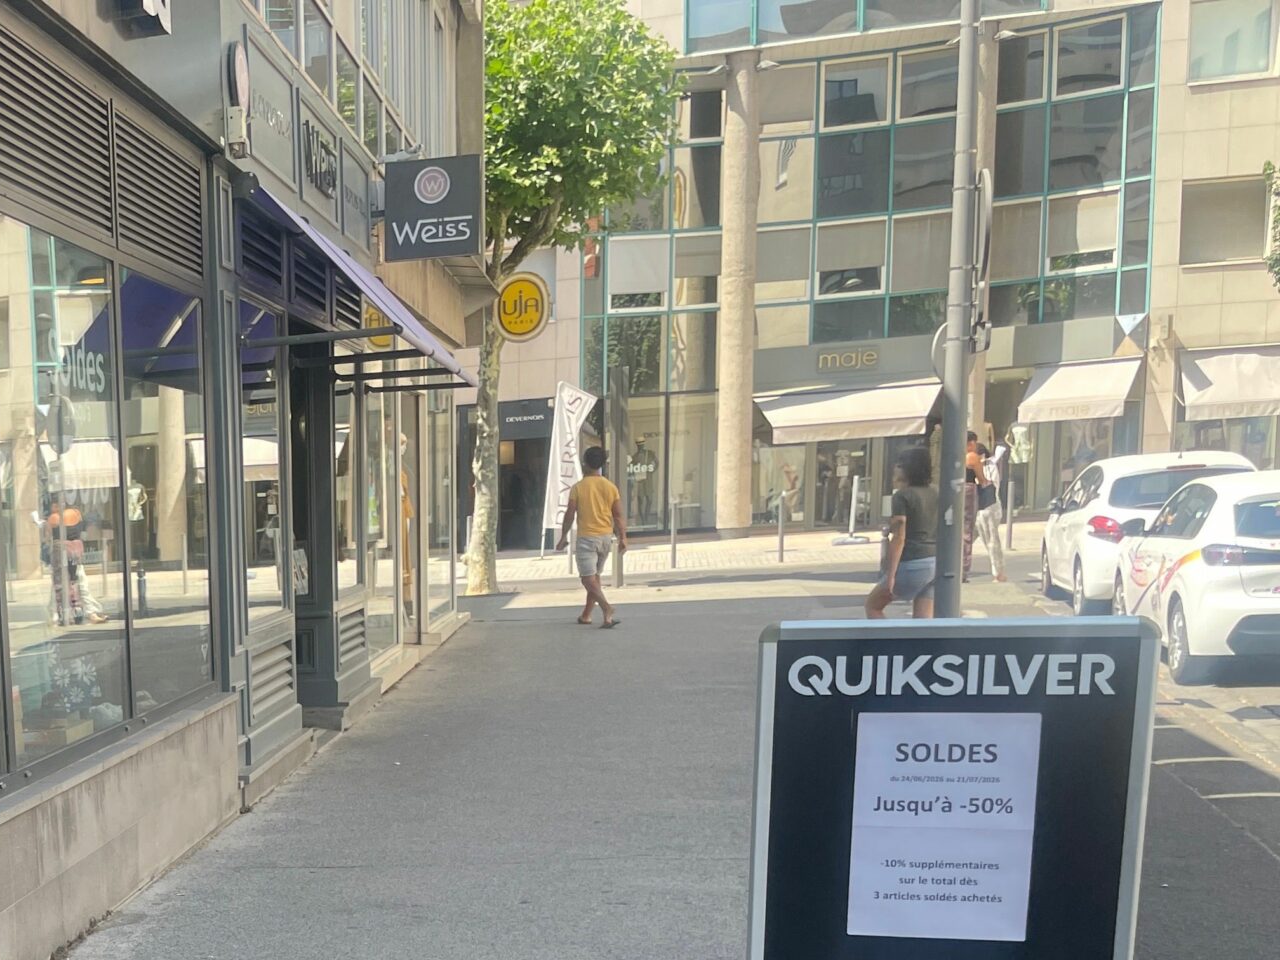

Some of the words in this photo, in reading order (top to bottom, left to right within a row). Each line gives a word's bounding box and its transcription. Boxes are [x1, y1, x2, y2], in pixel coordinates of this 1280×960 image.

[392, 214, 473, 246] Weiss
[818, 347, 878, 369] maje
[505, 414, 545, 423] DEVERNOIS
[787, 653, 1116, 697] QUIKSILVER
[895, 742, 998, 764] SOLDES
[890, 775, 901, 783] du
[960, 798, 1014, 815] -50%
[880, 859, 907, 869] -10%
[909, 860, 1000, 871] supplémentaires
[899, 877, 916, 885] sur
[918, 876, 928, 885] le
[931, 876, 957, 886] total
[959, 877, 979, 886] dès
[873, 891, 880, 900] 3
[882, 891, 921, 901] articles
[923, 892, 958, 902] soldés
[960, 893, 1003, 903] achetés
